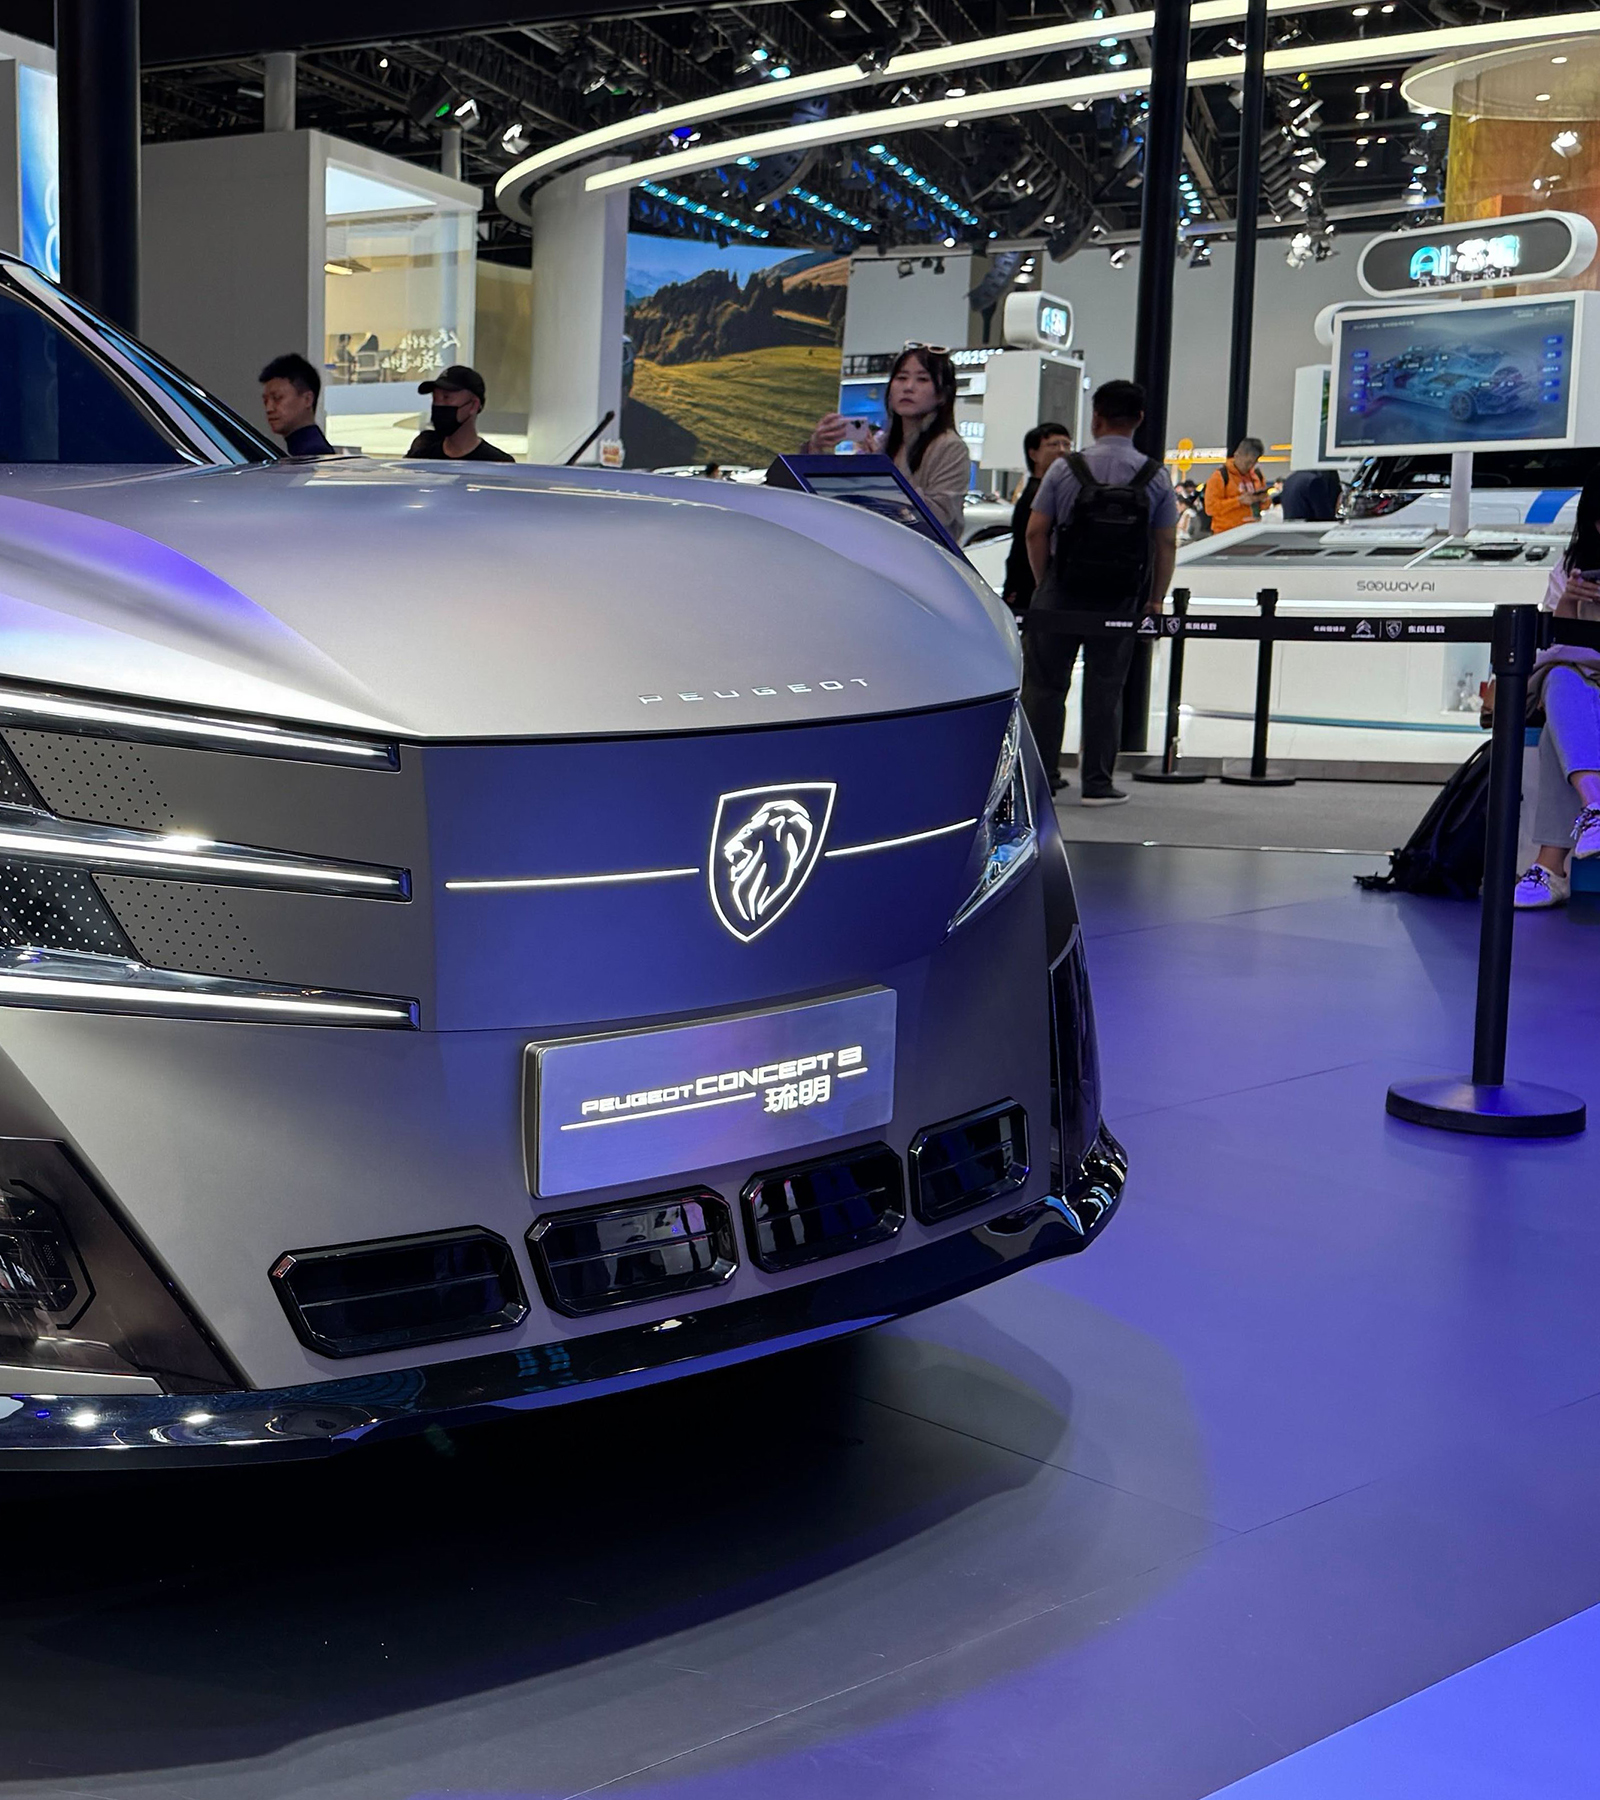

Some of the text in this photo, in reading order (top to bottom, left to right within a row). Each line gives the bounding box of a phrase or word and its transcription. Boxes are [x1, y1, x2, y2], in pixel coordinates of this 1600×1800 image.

[638, 678, 868, 704] PEUGEOT
[581, 1045, 862, 1115] PEUGEOT CONCEPT 8
[763, 1074, 831, 1113] 琉明
